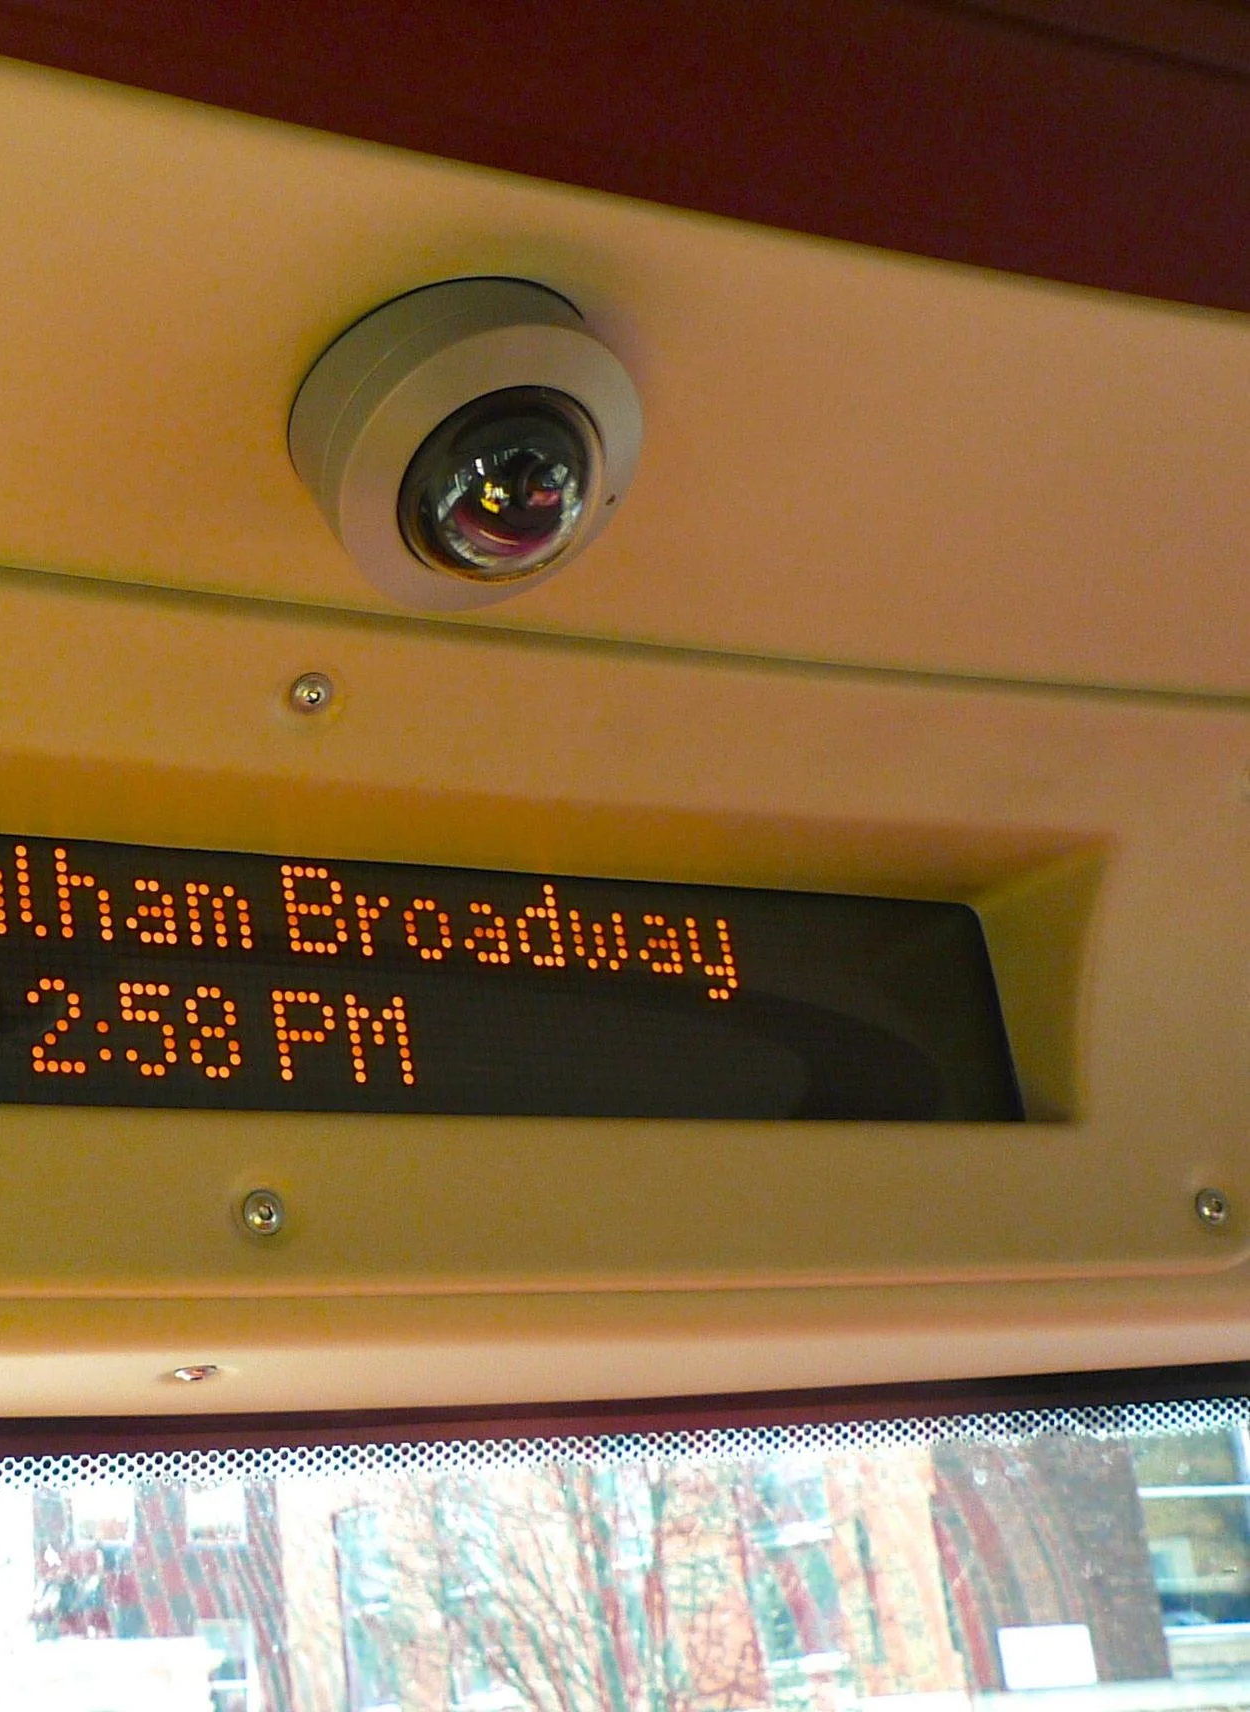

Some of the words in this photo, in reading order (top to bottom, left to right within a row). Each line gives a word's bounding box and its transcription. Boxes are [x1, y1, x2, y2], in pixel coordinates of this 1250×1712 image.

[280, 864, 739, 1001] Broadway
[27, 978, 242, 1079] 2:58
[271, 990, 415, 1085] PM
